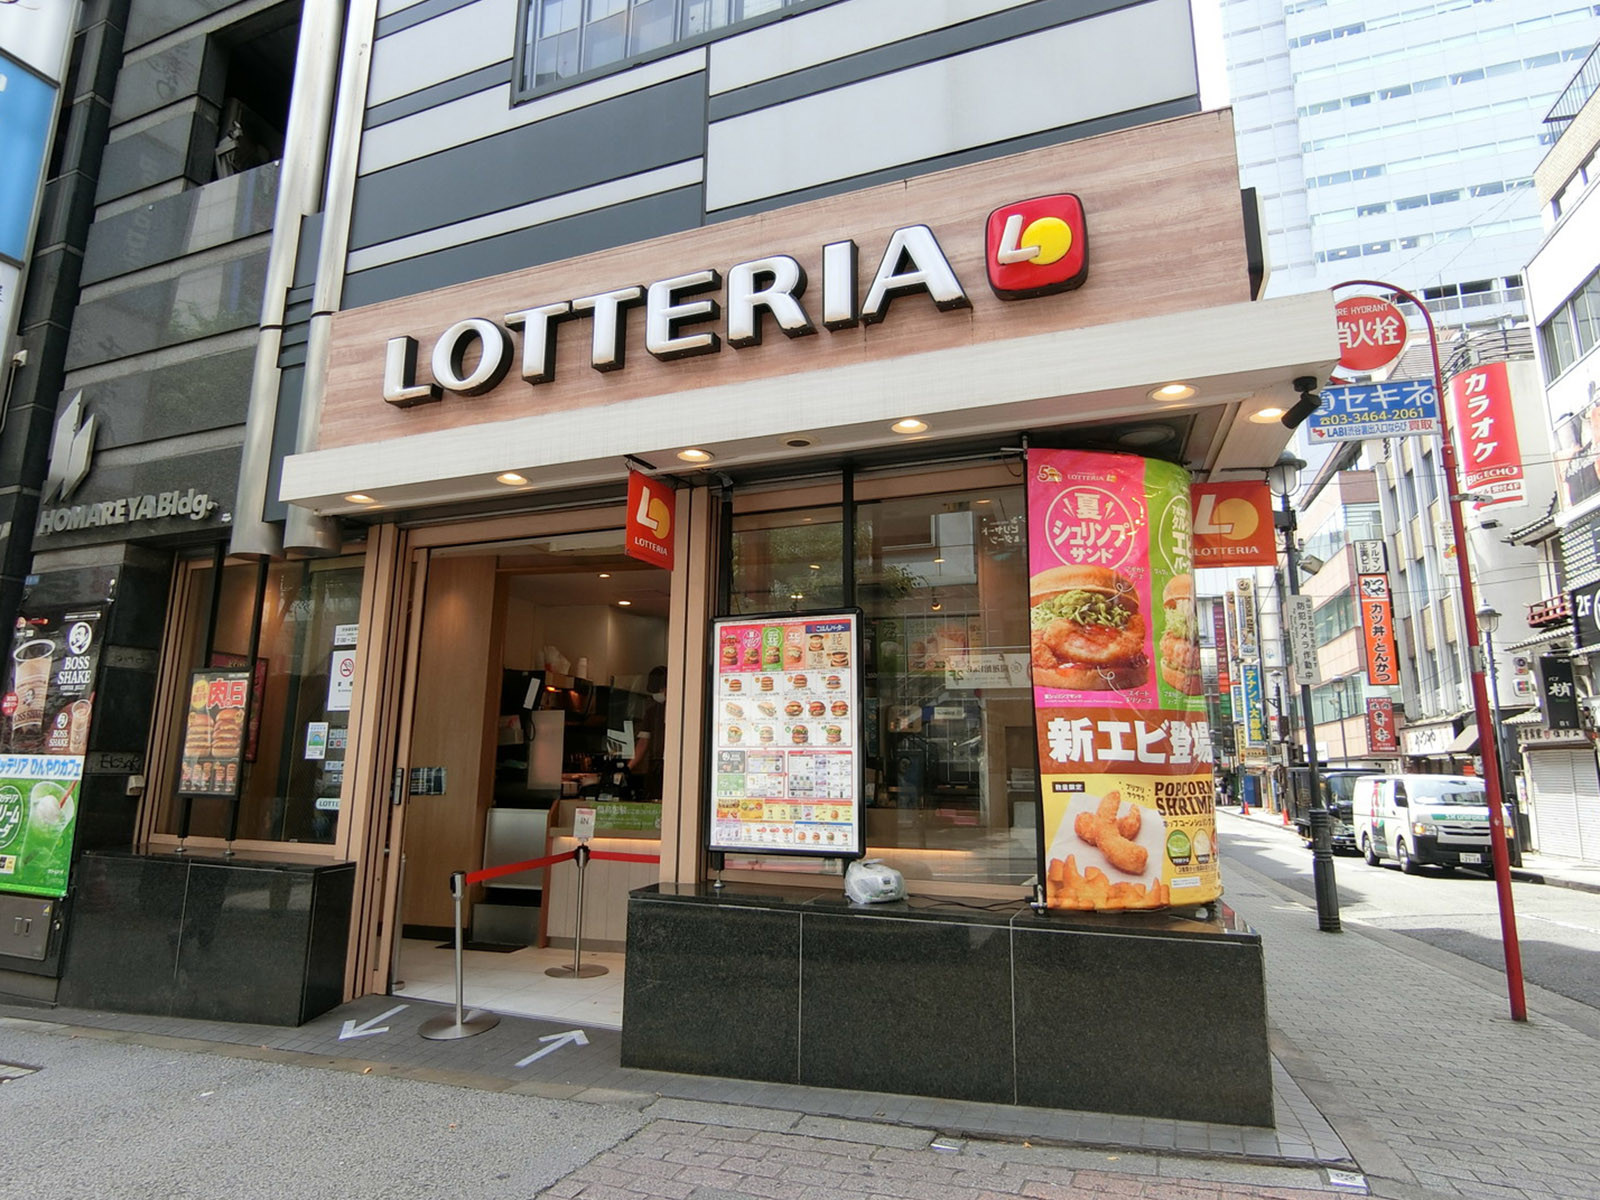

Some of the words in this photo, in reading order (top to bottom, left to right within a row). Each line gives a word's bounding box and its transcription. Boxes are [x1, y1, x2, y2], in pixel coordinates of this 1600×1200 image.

[382, 222, 972, 409] LOTTERIA
[1351, 304, 1388, 315] HYDRANT
[1338, 381, 1434, 412] セキネ
[1330, 407, 1424, 425] 03-3464-2061
[1408, 419, 1433, 431] 買取
[1465, 372, 1497, 463] カラオケ
[1466, 471, 1484, 487] BIG
[1484, 465, 1518, 478] ECHO
[1074, 492, 1102, 520] 夏
[1052, 519, 1130, 548] シュリンプ
[634, 536, 668, 556] LOTTERIA
[1070, 547, 1113, 563] サンド
[1194, 545, 1259, 556] LOTTERIA
[1362, 578, 1385, 597] かつや
[1575, 595, 1592, 617] 2F
[1296, 601, 1314, 679] 防犯カメラ作動中
[1370, 604, 1391, 682] カツ丼・とんかつ
[64, 656, 91, 670] BOSS
[57, 670, 92, 684] SHAKE
[207, 677, 247, 709] 肉の日
[1246, 670, 1262, 741] テナント大募集
[52, 729, 69, 738] BOSS
[1047, 716, 1213, 764] 新エビ登場
[31, 758, 81, 777] ひんやりカフェ
[1154, 780, 1213, 797] POPCORN
